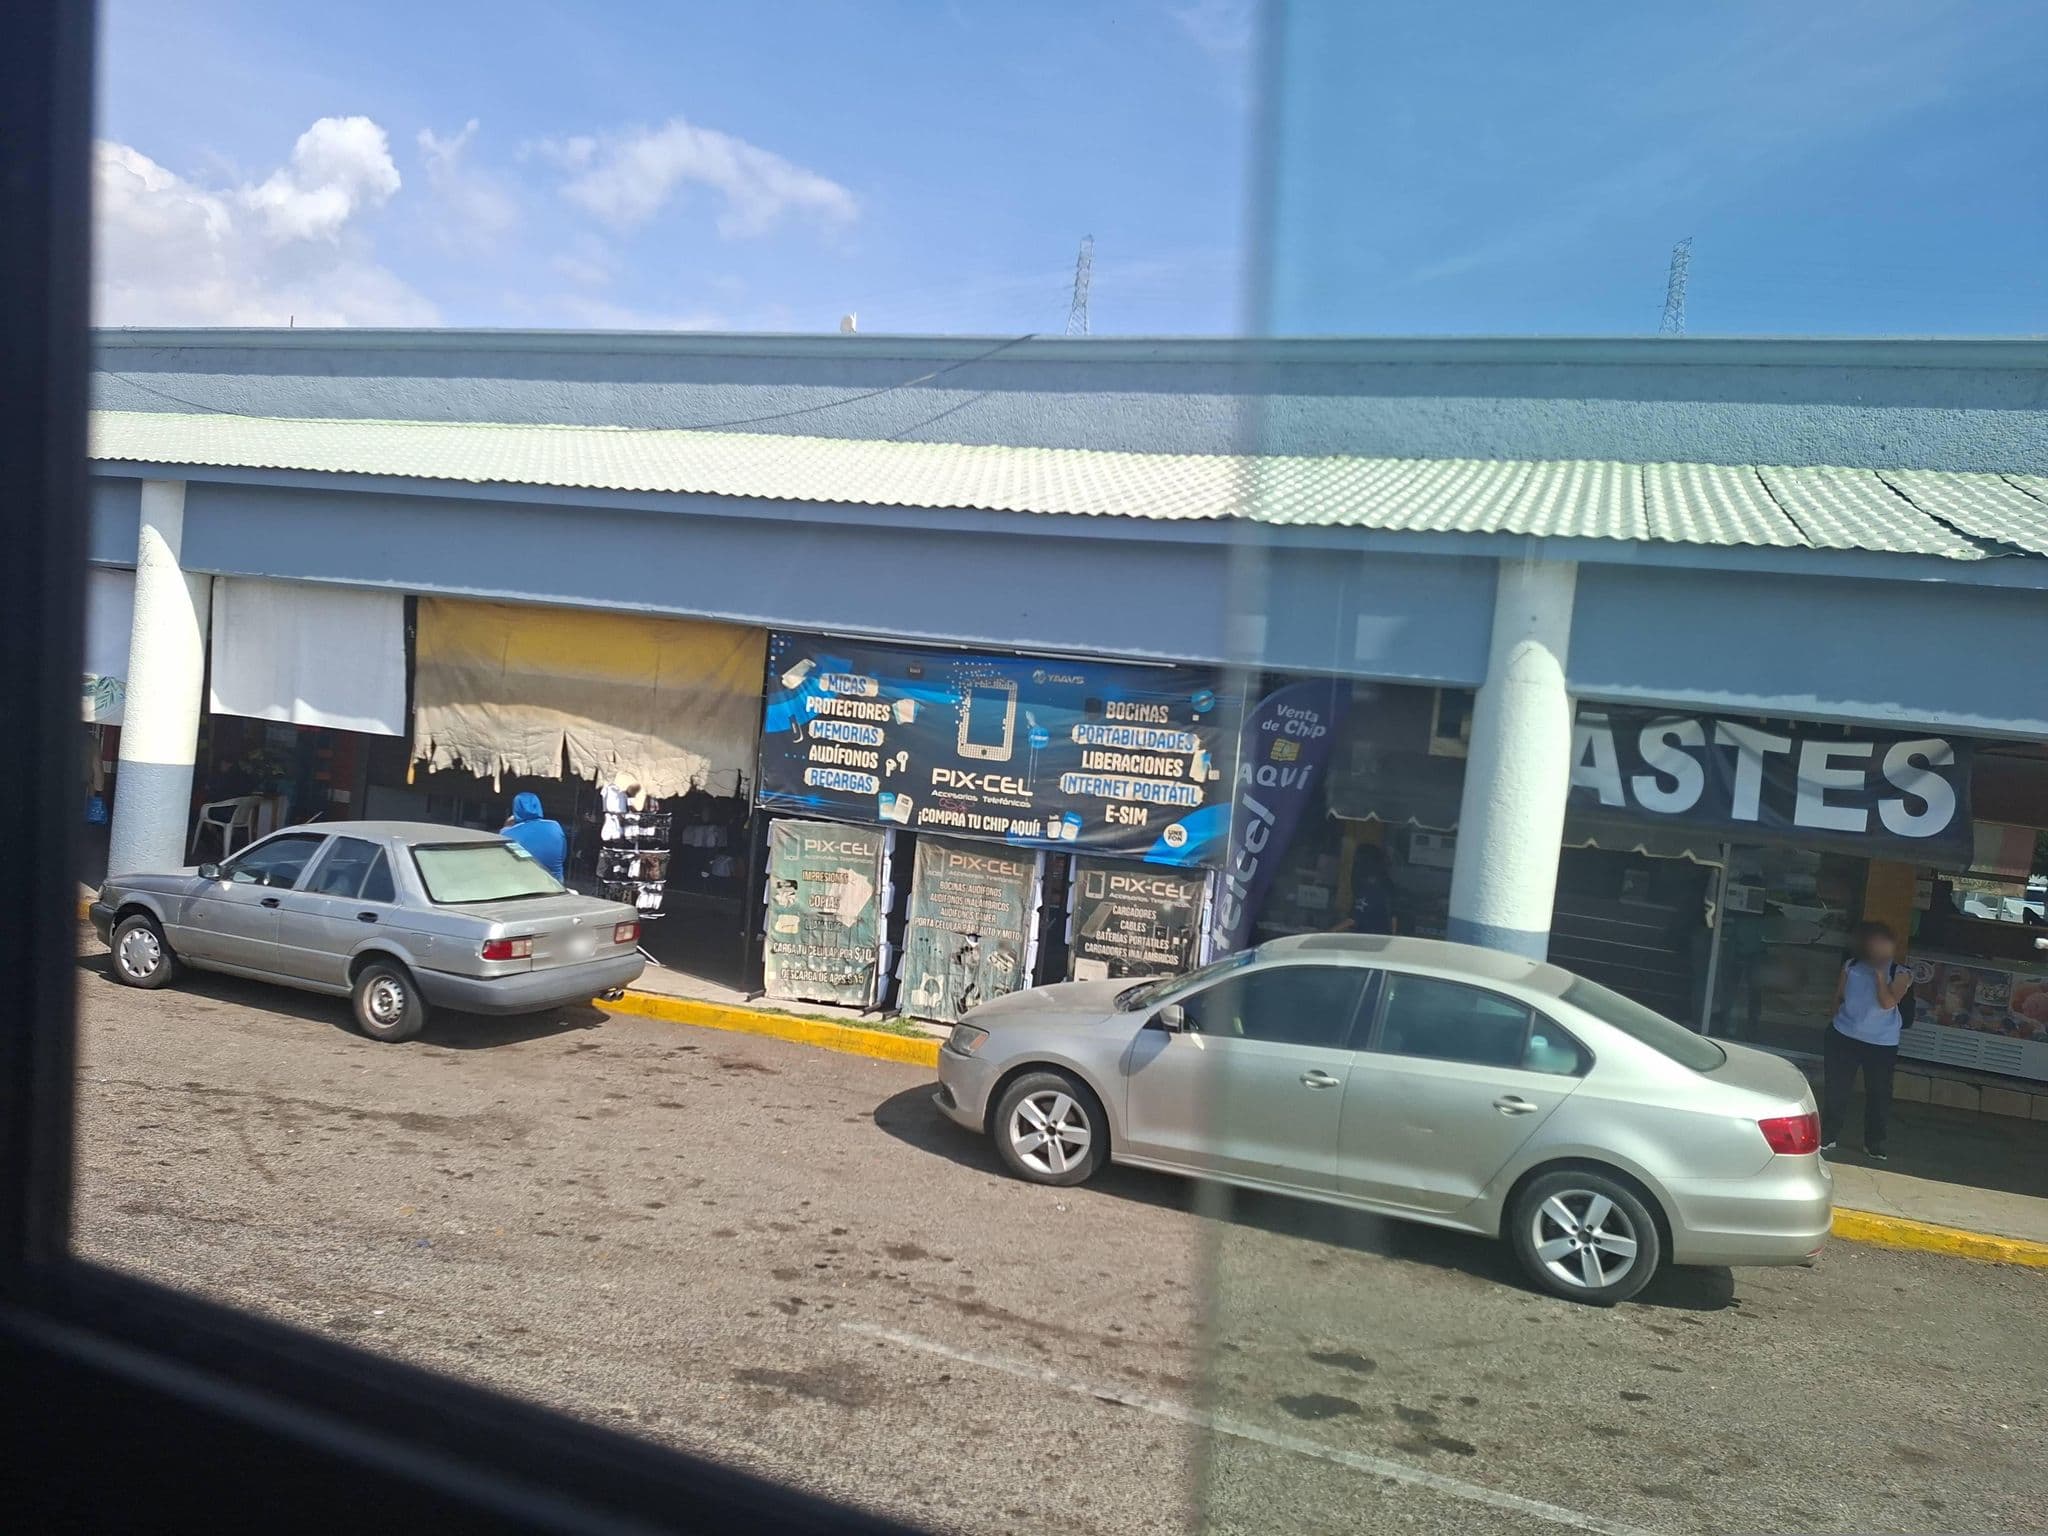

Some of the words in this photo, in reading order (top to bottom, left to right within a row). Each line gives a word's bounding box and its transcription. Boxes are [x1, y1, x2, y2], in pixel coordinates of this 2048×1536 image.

[828, 674, 867, 693] MICAS
[805, 696, 891, 722] PROTECTORES
[1105, 701, 1169, 723] BOCINAS
[1276, 703, 1319, 723] Venta
[813, 721, 879, 744] MEMORIAS
[1076, 724, 1195, 751] PORTABILIDADES
[1262, 719, 1280, 732] de
[1284, 720, 1326, 739] Chip
[808, 743, 879, 769] AUDÍFONOS
[1081, 751, 1184, 777] LIBERACIONES
[811, 769, 873, 791] RECARGAS
[931, 768, 1033, 797] PIX-CEL
[1063, 775, 1129, 799] INTERNET
[1132, 782, 1198, 805] PORTÁTIL
[931, 789, 978, 802] Accesorios
[982, 795, 1031, 808] Telefónicos
[917, 807, 966, 827] ¡COMPRA
[968, 813, 982, 830] TU
[983, 816, 1009, 832] CHIP
[1010, 819, 1041, 838] AQUÍ!
[1105, 804, 1148, 826] E-SIM
[804, 839, 875, 856] PIX-CEL
[950, 855, 1023, 877] PIX-CEL
[1110, 876, 1192, 899] PIX-CEL
[809, 895, 840, 909] COPIAS
[1112, 905, 1157, 920] CARGADORES
[935, 920, 961, 931] CELULAR
[979, 926, 996, 936] AUTO
[1002, 930, 1020, 941] MOTO
[1120, 920, 1146, 932] CABLES
[773, 942, 797, 955] CARGA
[798, 945, 807, 956] TU
[808, 945, 838, 959] CELULAR
[839, 948, 852, 959] POR
[1085, 942, 1128, 958] CARGADORES
[781, 969, 817, 982] DESCARGA
[818, 971, 828, 982] DE
